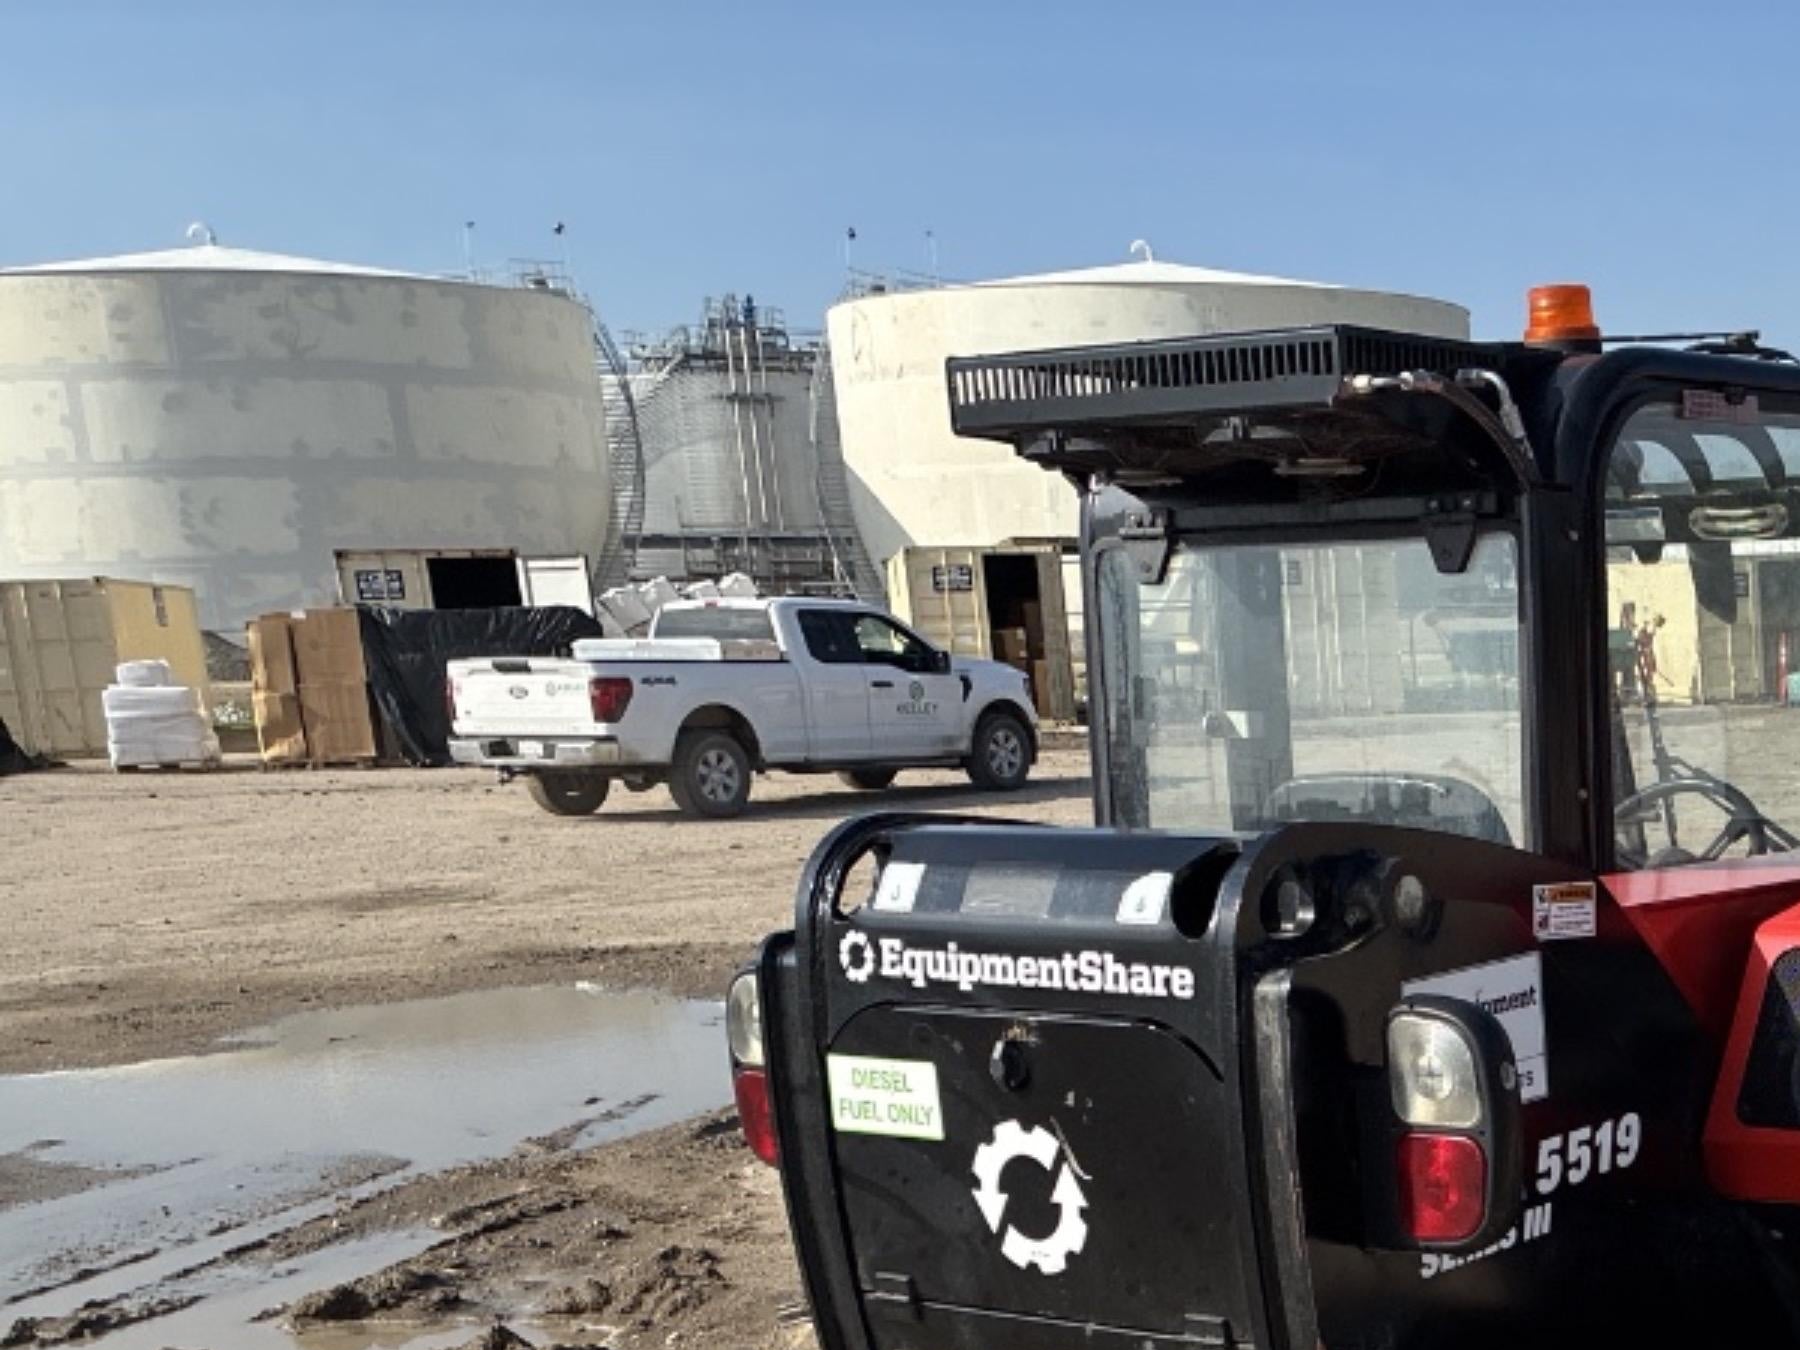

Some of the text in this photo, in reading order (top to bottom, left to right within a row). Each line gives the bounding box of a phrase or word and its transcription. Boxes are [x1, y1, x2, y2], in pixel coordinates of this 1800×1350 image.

[878, 939, 1195, 998] EquipmentShare
[851, 1066, 913, 1093] DIESEL
[839, 1098, 933, 1126] FUEL ONLY
[1536, 1112, 1642, 1195] 5519
